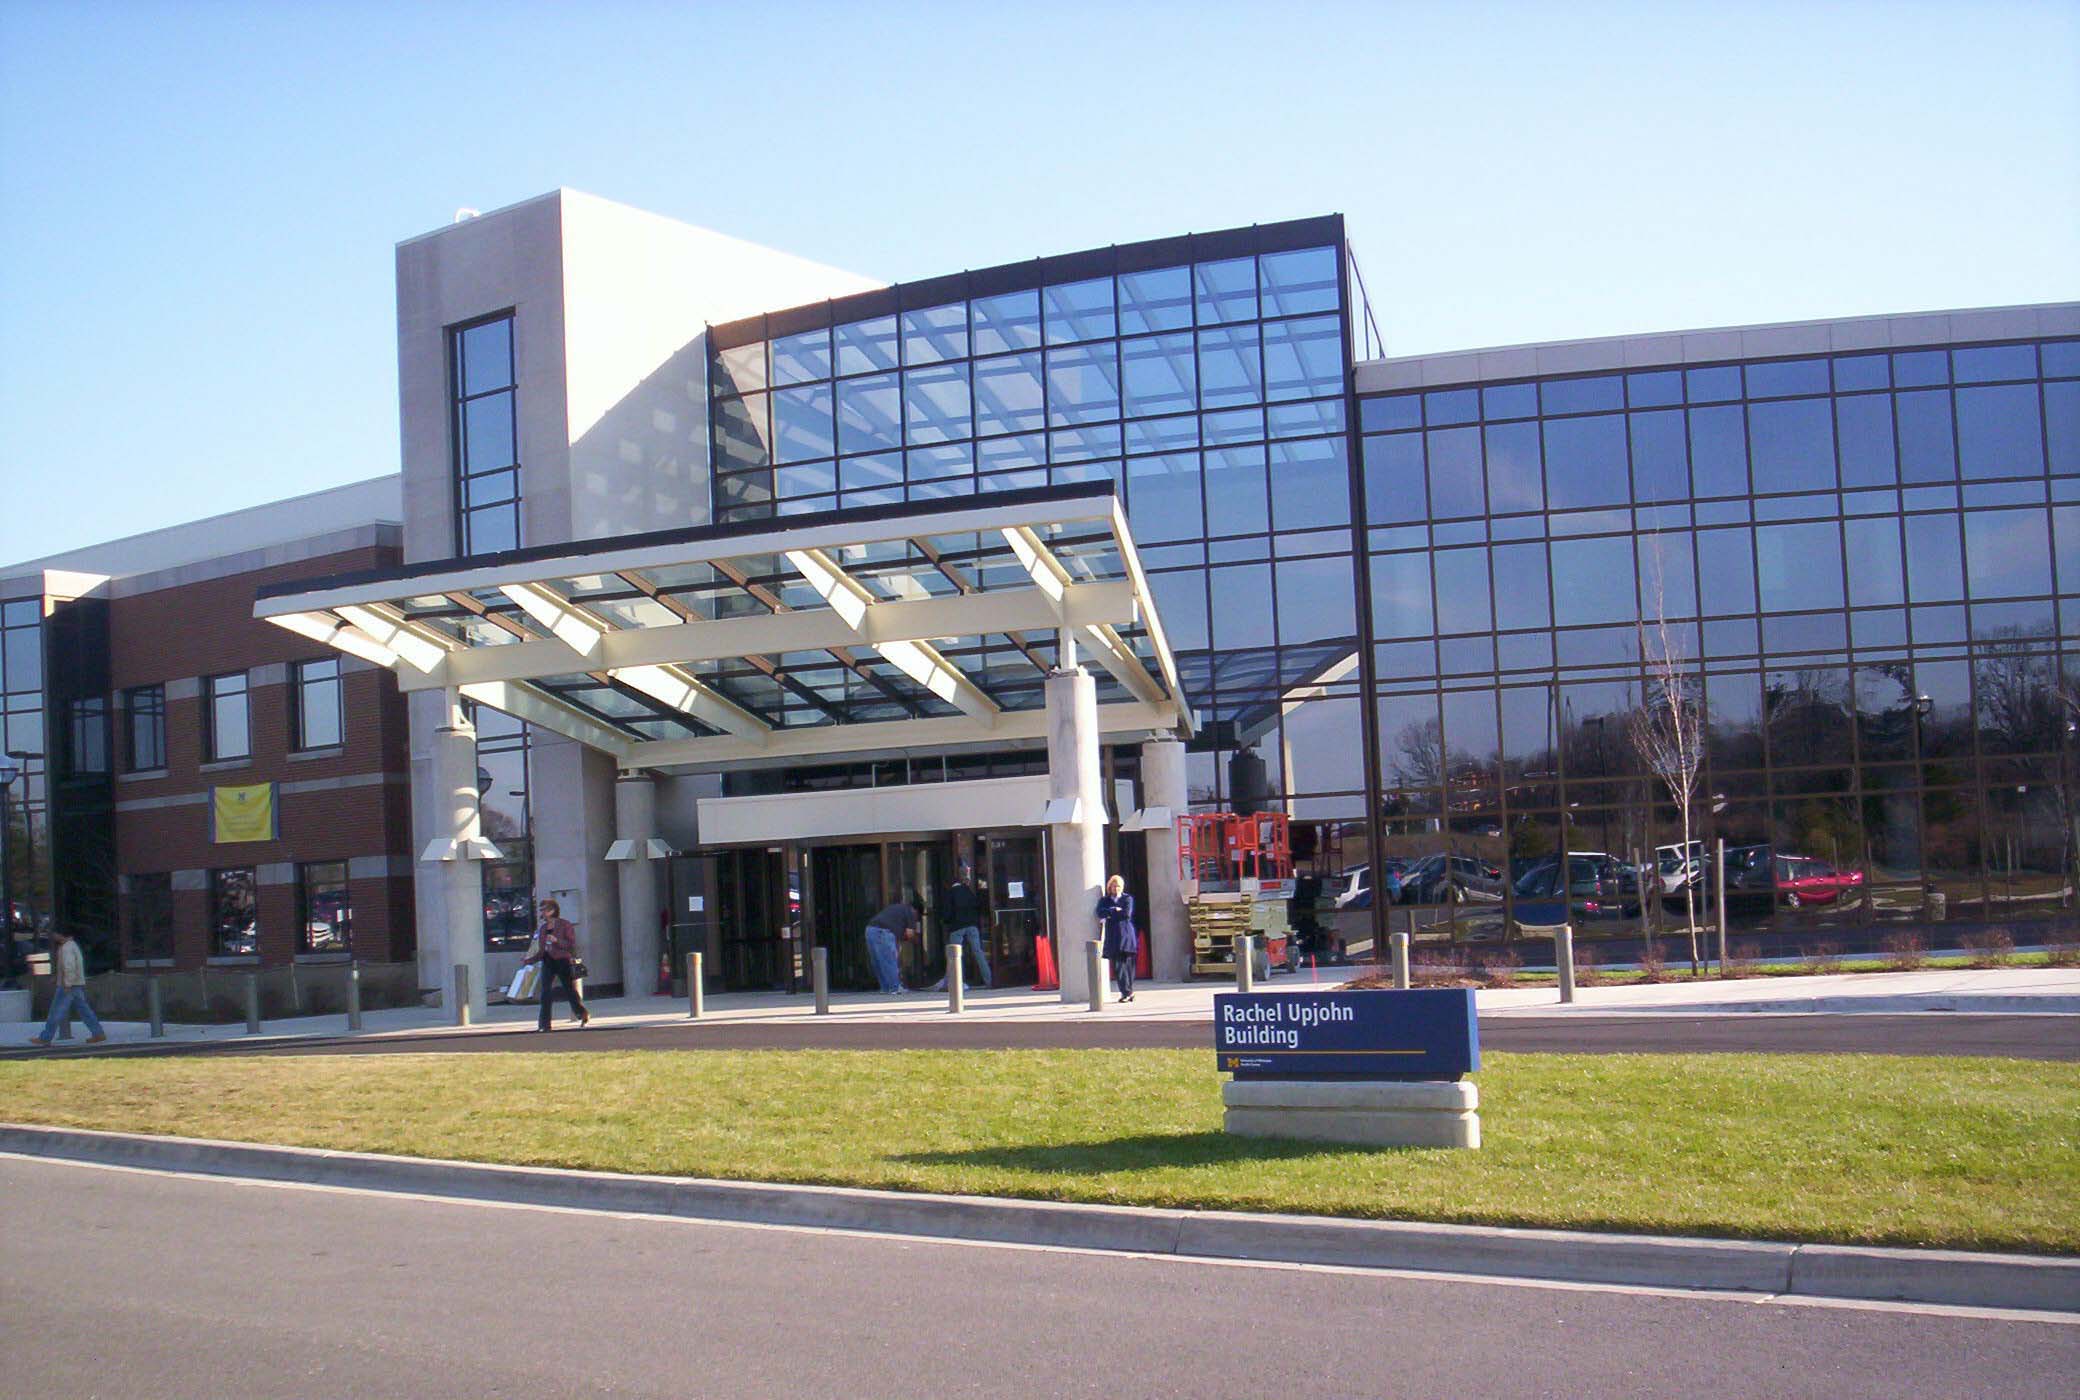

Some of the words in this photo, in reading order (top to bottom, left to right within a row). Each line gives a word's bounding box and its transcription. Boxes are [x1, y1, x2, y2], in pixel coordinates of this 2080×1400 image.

[1223, 1002, 1281, 1022] Rachel
[1288, 1002, 1354, 1026] Upjohn
[1225, 1025, 1299, 1048] Building
